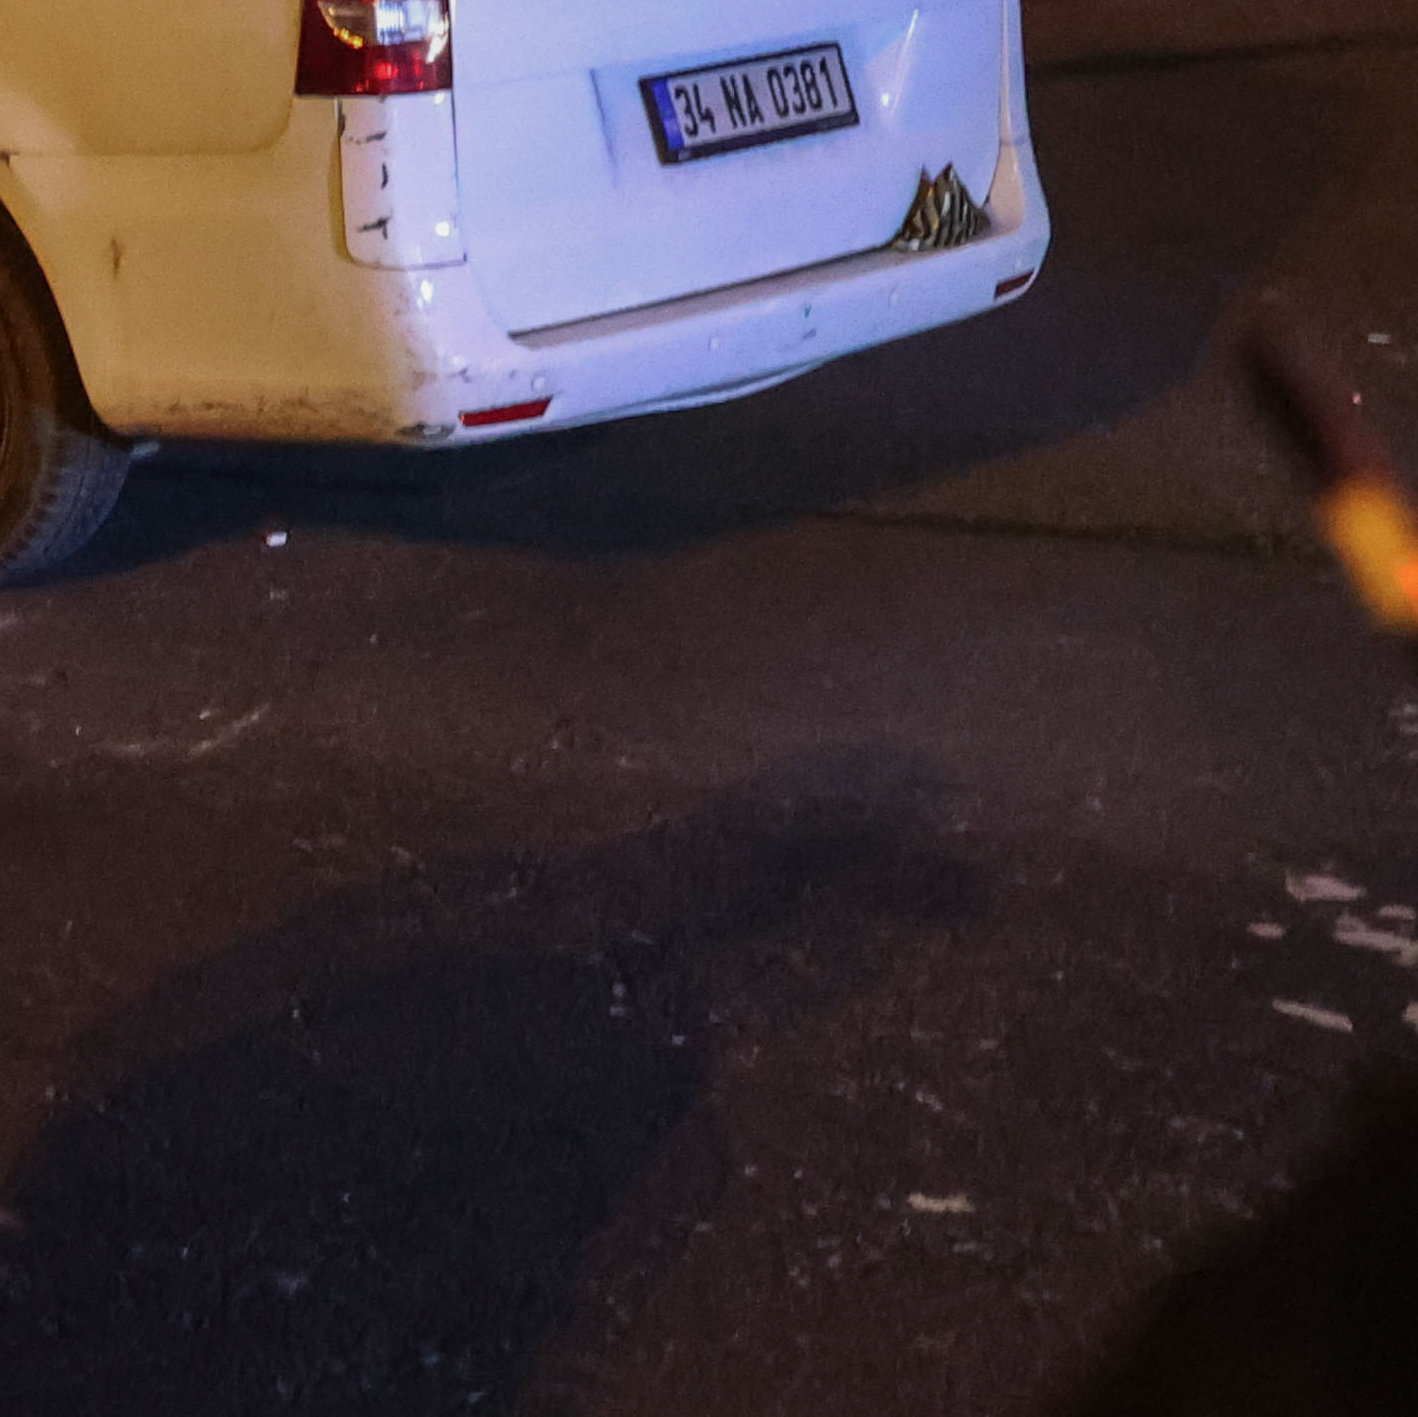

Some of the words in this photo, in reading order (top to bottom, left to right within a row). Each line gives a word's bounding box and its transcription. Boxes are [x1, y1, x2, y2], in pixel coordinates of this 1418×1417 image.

[673, 82, 717, 138] 34
[719, 72, 765, 130] NA
[765, 55, 839, 119] 0381
